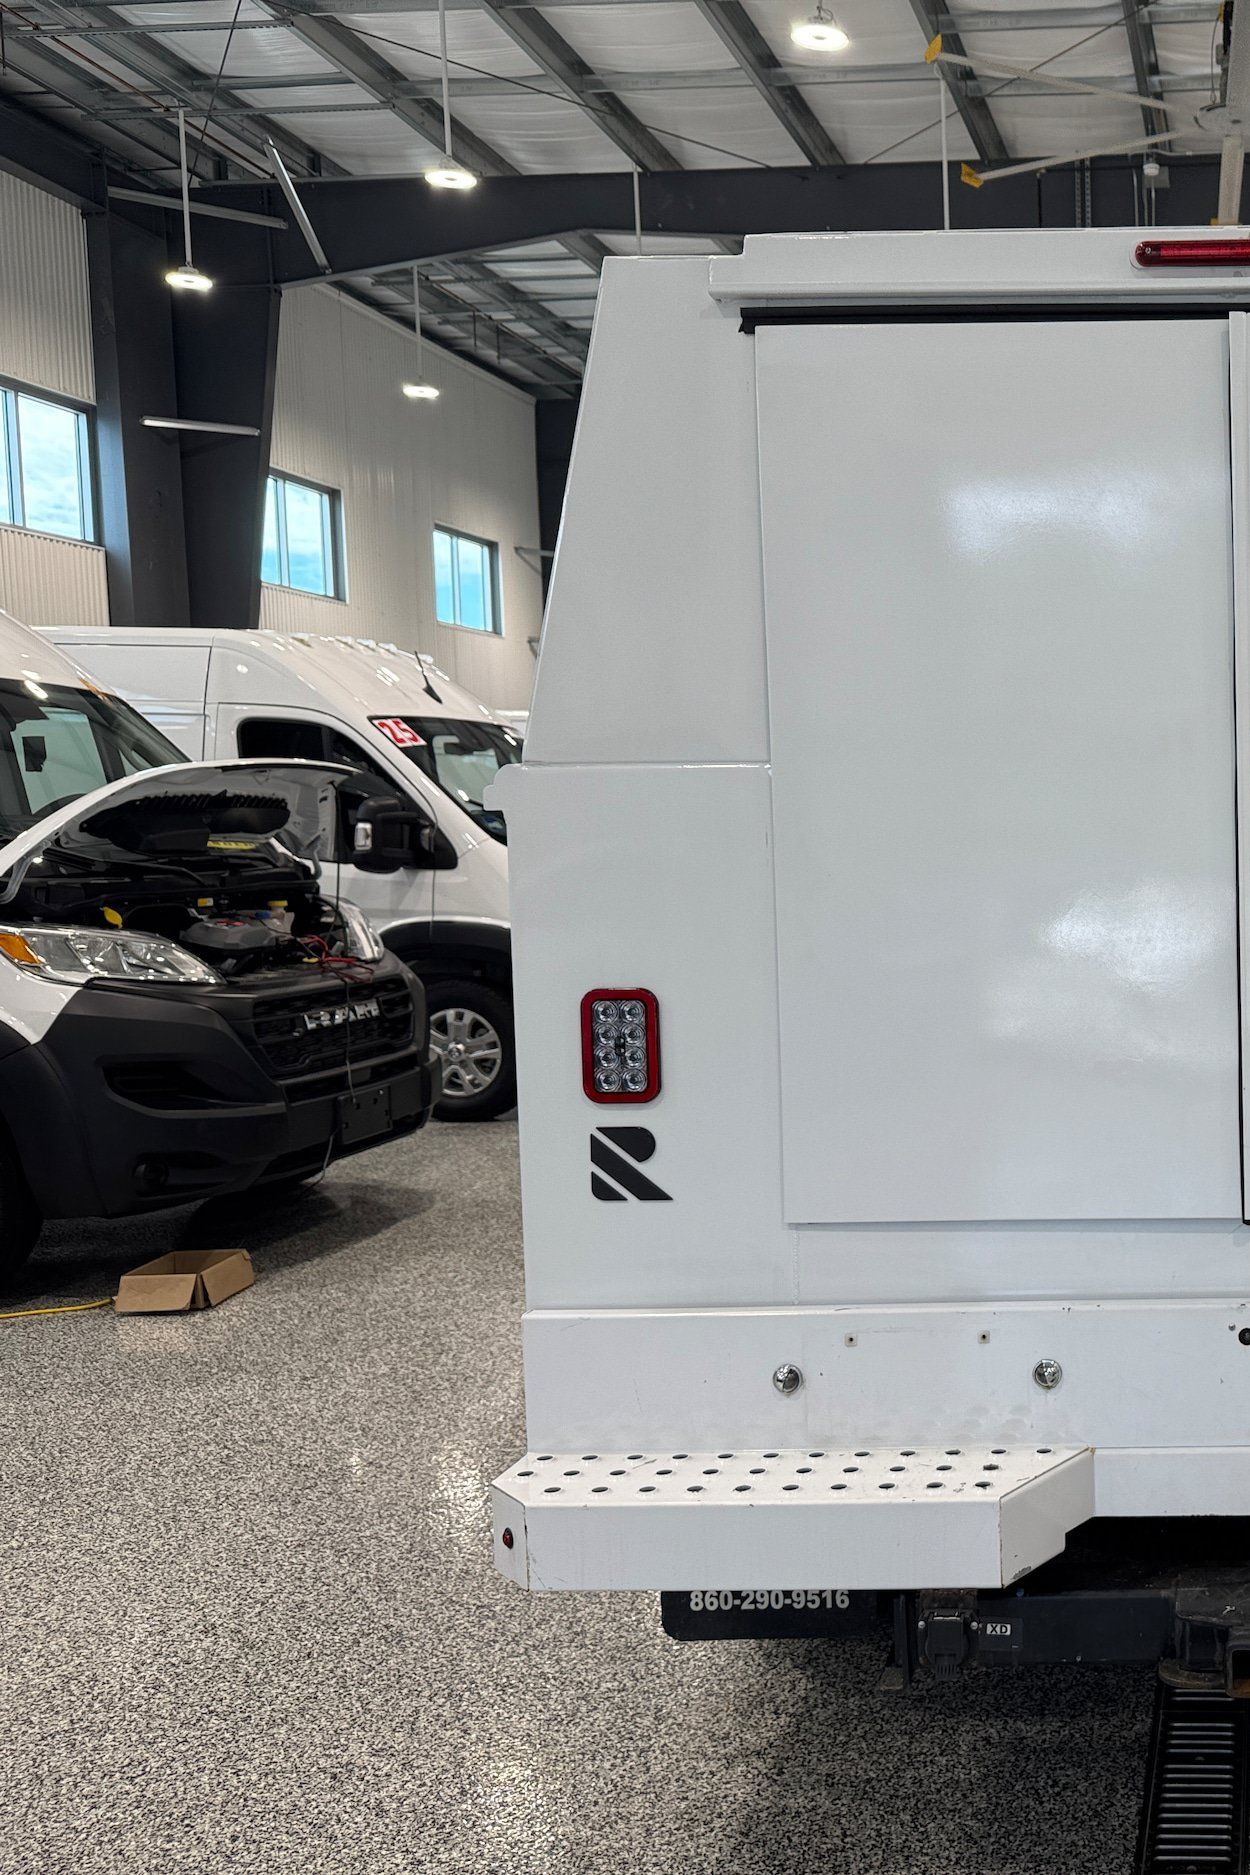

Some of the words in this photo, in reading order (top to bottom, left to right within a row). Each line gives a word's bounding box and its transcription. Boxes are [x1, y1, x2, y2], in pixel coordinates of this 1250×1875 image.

[378, 720, 419, 743] 25
[303, 1000, 380, 1030] RAM
[690, 1590, 850, 1611] 860-290-9516
[990, 1624, 1008, 1634] XD
